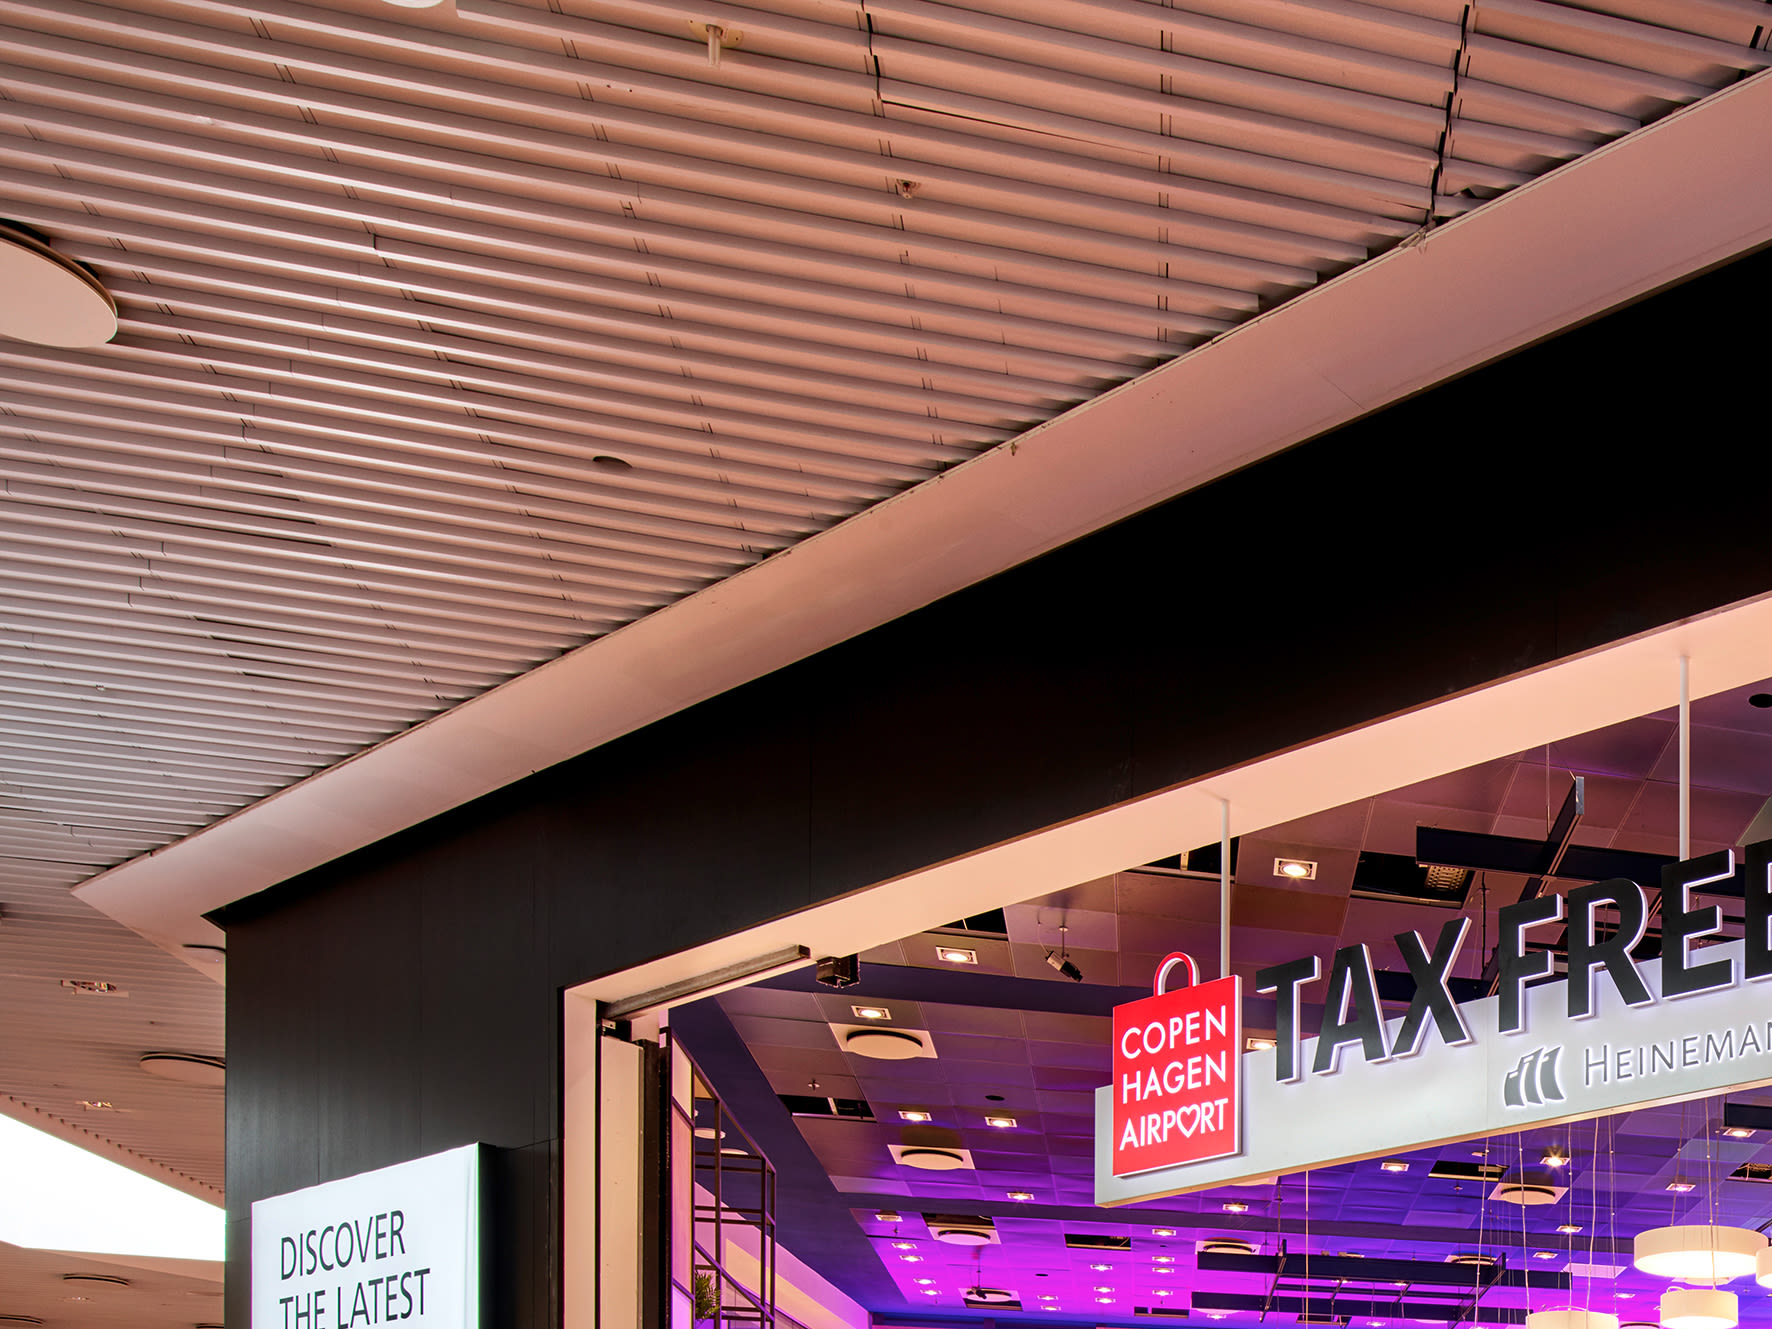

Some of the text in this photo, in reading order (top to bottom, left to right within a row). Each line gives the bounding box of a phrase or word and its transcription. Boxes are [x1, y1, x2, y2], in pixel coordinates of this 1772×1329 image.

[1256, 917, 1473, 1083] TAX
[1121, 1005, 1226, 1060] COPEN
[1122, 1051, 1226, 1105] HAGEN
[280, 1209, 406, 1281] DISCOVER
